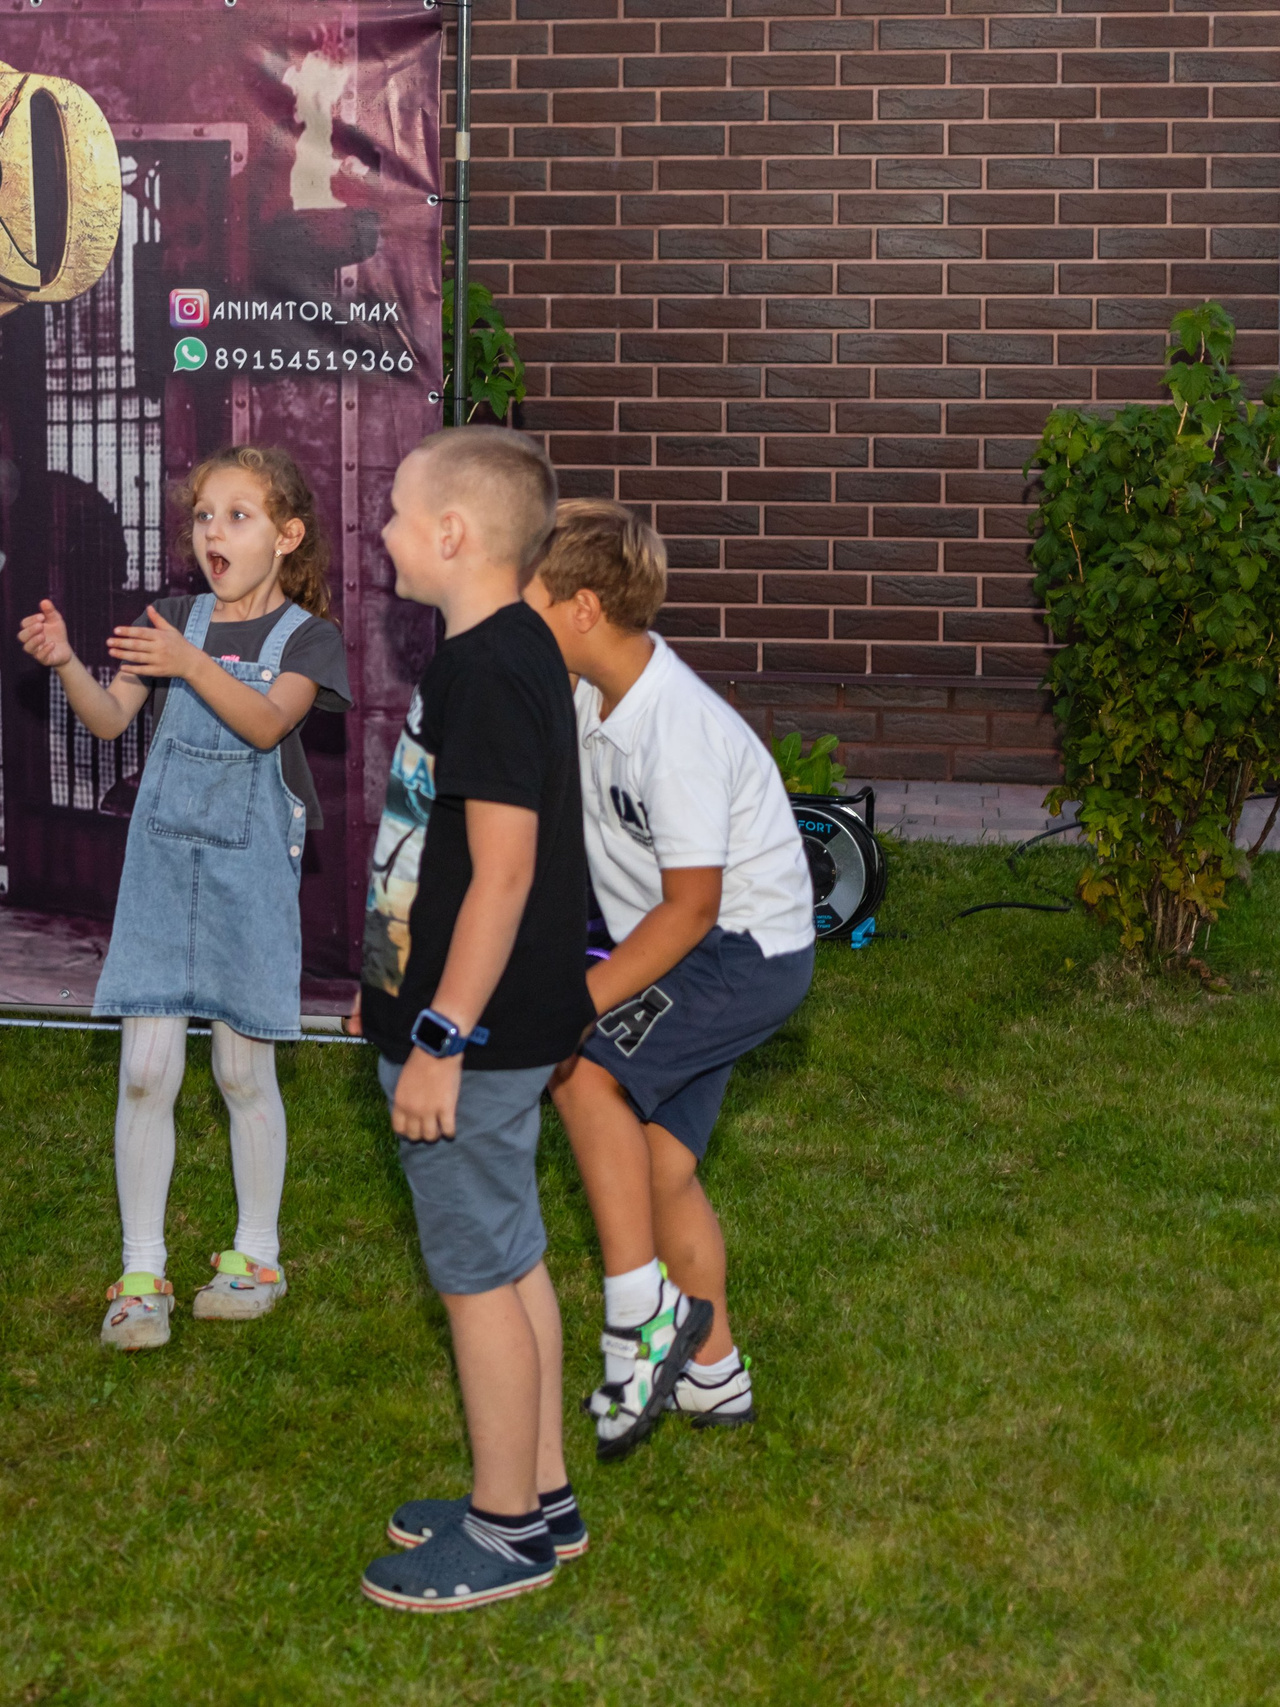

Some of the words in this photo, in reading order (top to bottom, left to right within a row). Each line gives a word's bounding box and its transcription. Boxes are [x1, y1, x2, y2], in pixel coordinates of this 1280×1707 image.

[212, 300, 400, 325] ANIMATOR_MAX
[214, 347, 414, 373] 89154519366
[797, 819, 834, 835] FORT
